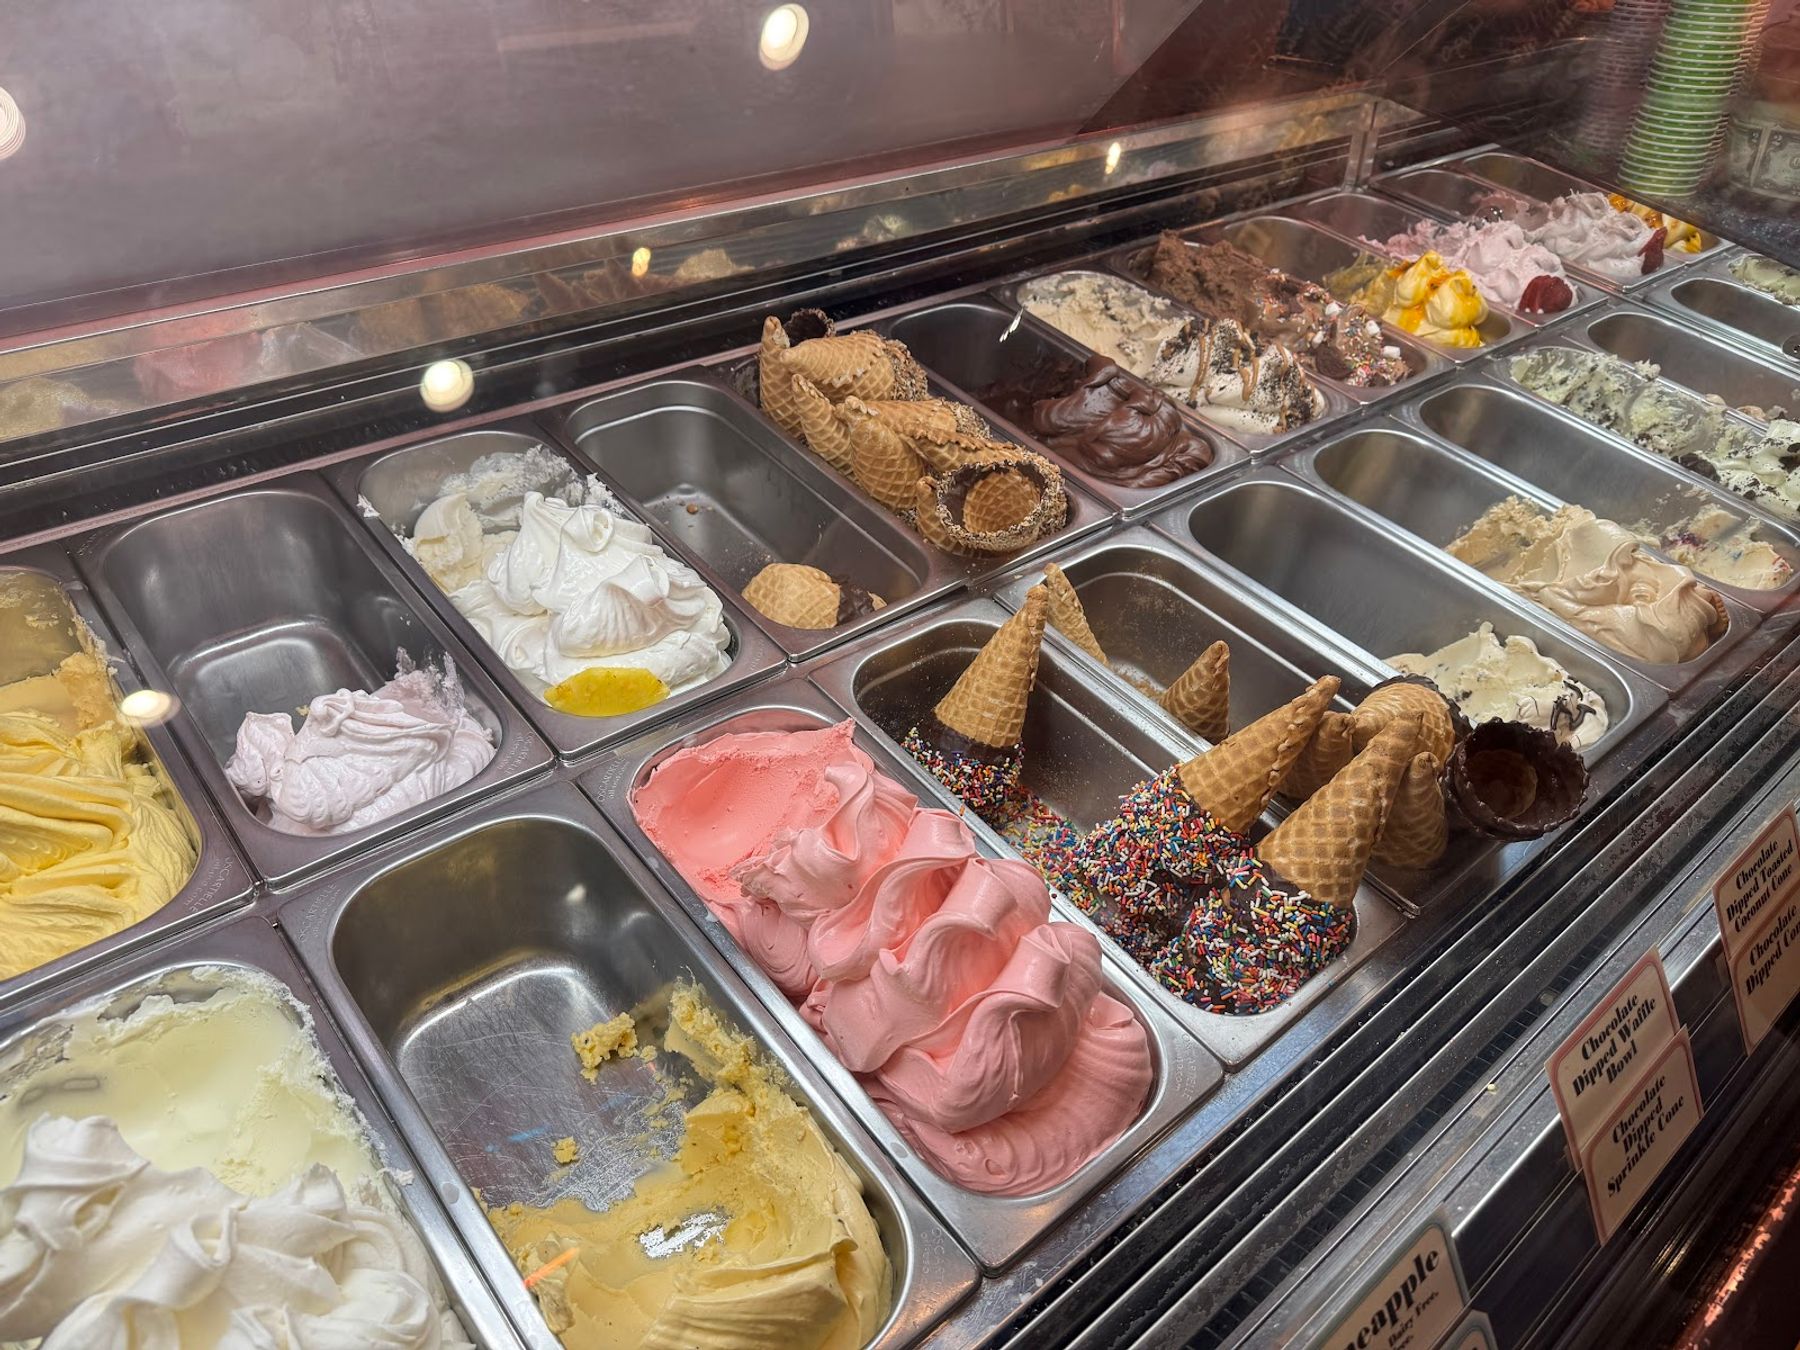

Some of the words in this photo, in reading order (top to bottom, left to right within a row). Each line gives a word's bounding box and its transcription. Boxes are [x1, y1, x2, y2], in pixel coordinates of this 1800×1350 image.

[1726, 877, 1760, 921] Dipped
[1760, 839, 1794, 883] Toasted
[1736, 840, 1778, 890] Chocolate
[1735, 886, 1770, 933] Coconut
[1771, 864, 1792, 891] Cone
[1750, 905, 1797, 966] Chocolate
[1746, 940, 1782, 995] Dipped
[1572, 1038, 1617, 1097] Dipped
[1618, 998, 1656, 1043] Waffle
[1581, 994, 1638, 1060] Chocolate
[1606, 1040, 1638, 1084] Bowl
[1612, 1075, 1665, 1144] Chocolate
[1622, 1096, 1663, 1154] Dipped
[1607, 1131, 1655, 1198] Sprinkle
[1657, 1096, 1684, 1132] Cone
[1389, 1316, 1413, 1347] Dairy
